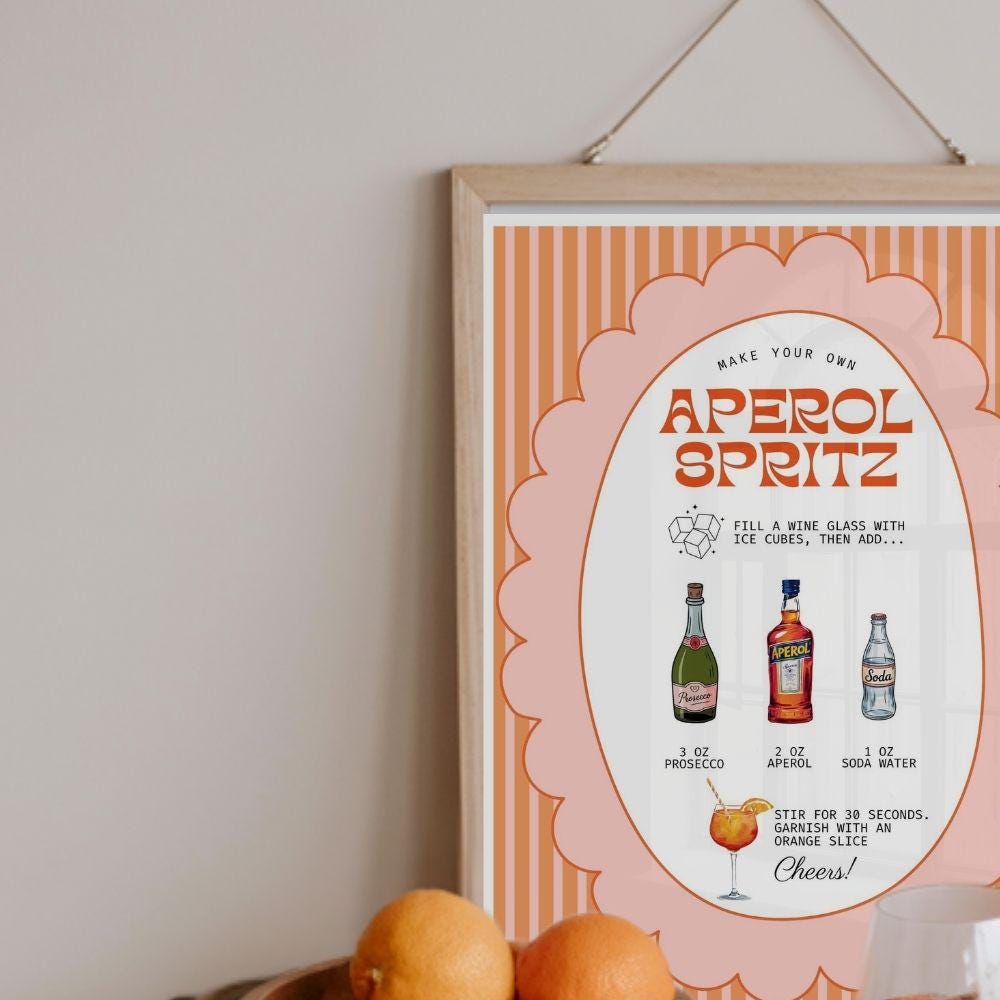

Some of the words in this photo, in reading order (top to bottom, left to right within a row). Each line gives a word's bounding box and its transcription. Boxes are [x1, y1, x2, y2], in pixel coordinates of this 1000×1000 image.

[717, 349, 759, 372] MAKE
[771, 346, 814, 360] YOUR
[825, 352, 857, 371] OWN
[658, 387, 914, 435] APEROL
[674, 441, 898, 488] SPRITZ
[733, 520, 765, 532] FILL
[771, 520, 782, 532] A
[787, 520, 820, 532] WINE
[826, 520, 867, 532] GLASS
[873, 520, 906, 532] WITH
[733, 533, 757, 545] ICE
[764, 533, 811, 547] CUBES,
[819, 533, 851, 545] THEN
[857, 533, 905, 545] ADD...
[772, 643, 811, 660] APEROL
[864, 668, 893, 683] Soda
[678, 691, 712, 704] Prosecco
[679, 746, 687, 758] 3
[693, 746, 710, 758] OZ
[775, 746, 782, 757] 2
[789, 746, 806, 757] OZ
[864, 746, 872, 757] 1
[878, 746, 895, 757] OZ
[664, 758, 725, 770] PROSECCO
[766, 757, 813, 769] APEROL
[841, 757, 872, 769] SODA
[878, 757, 917, 769] WATER
[774, 809, 806, 821] STIR
[813, 809, 838, 821] FOR
[844, 809, 861, 821] 30
[868, 809, 930, 821] SECONDS.
[774, 822, 830, 834] GARNISH
[836, 822, 868, 834] WITH
[875, 822, 892, 834] AN
[774, 835, 821, 847] ORANGE
[828, 835, 868, 847] SLICE
[773, 855, 858, 883] Cheers!
